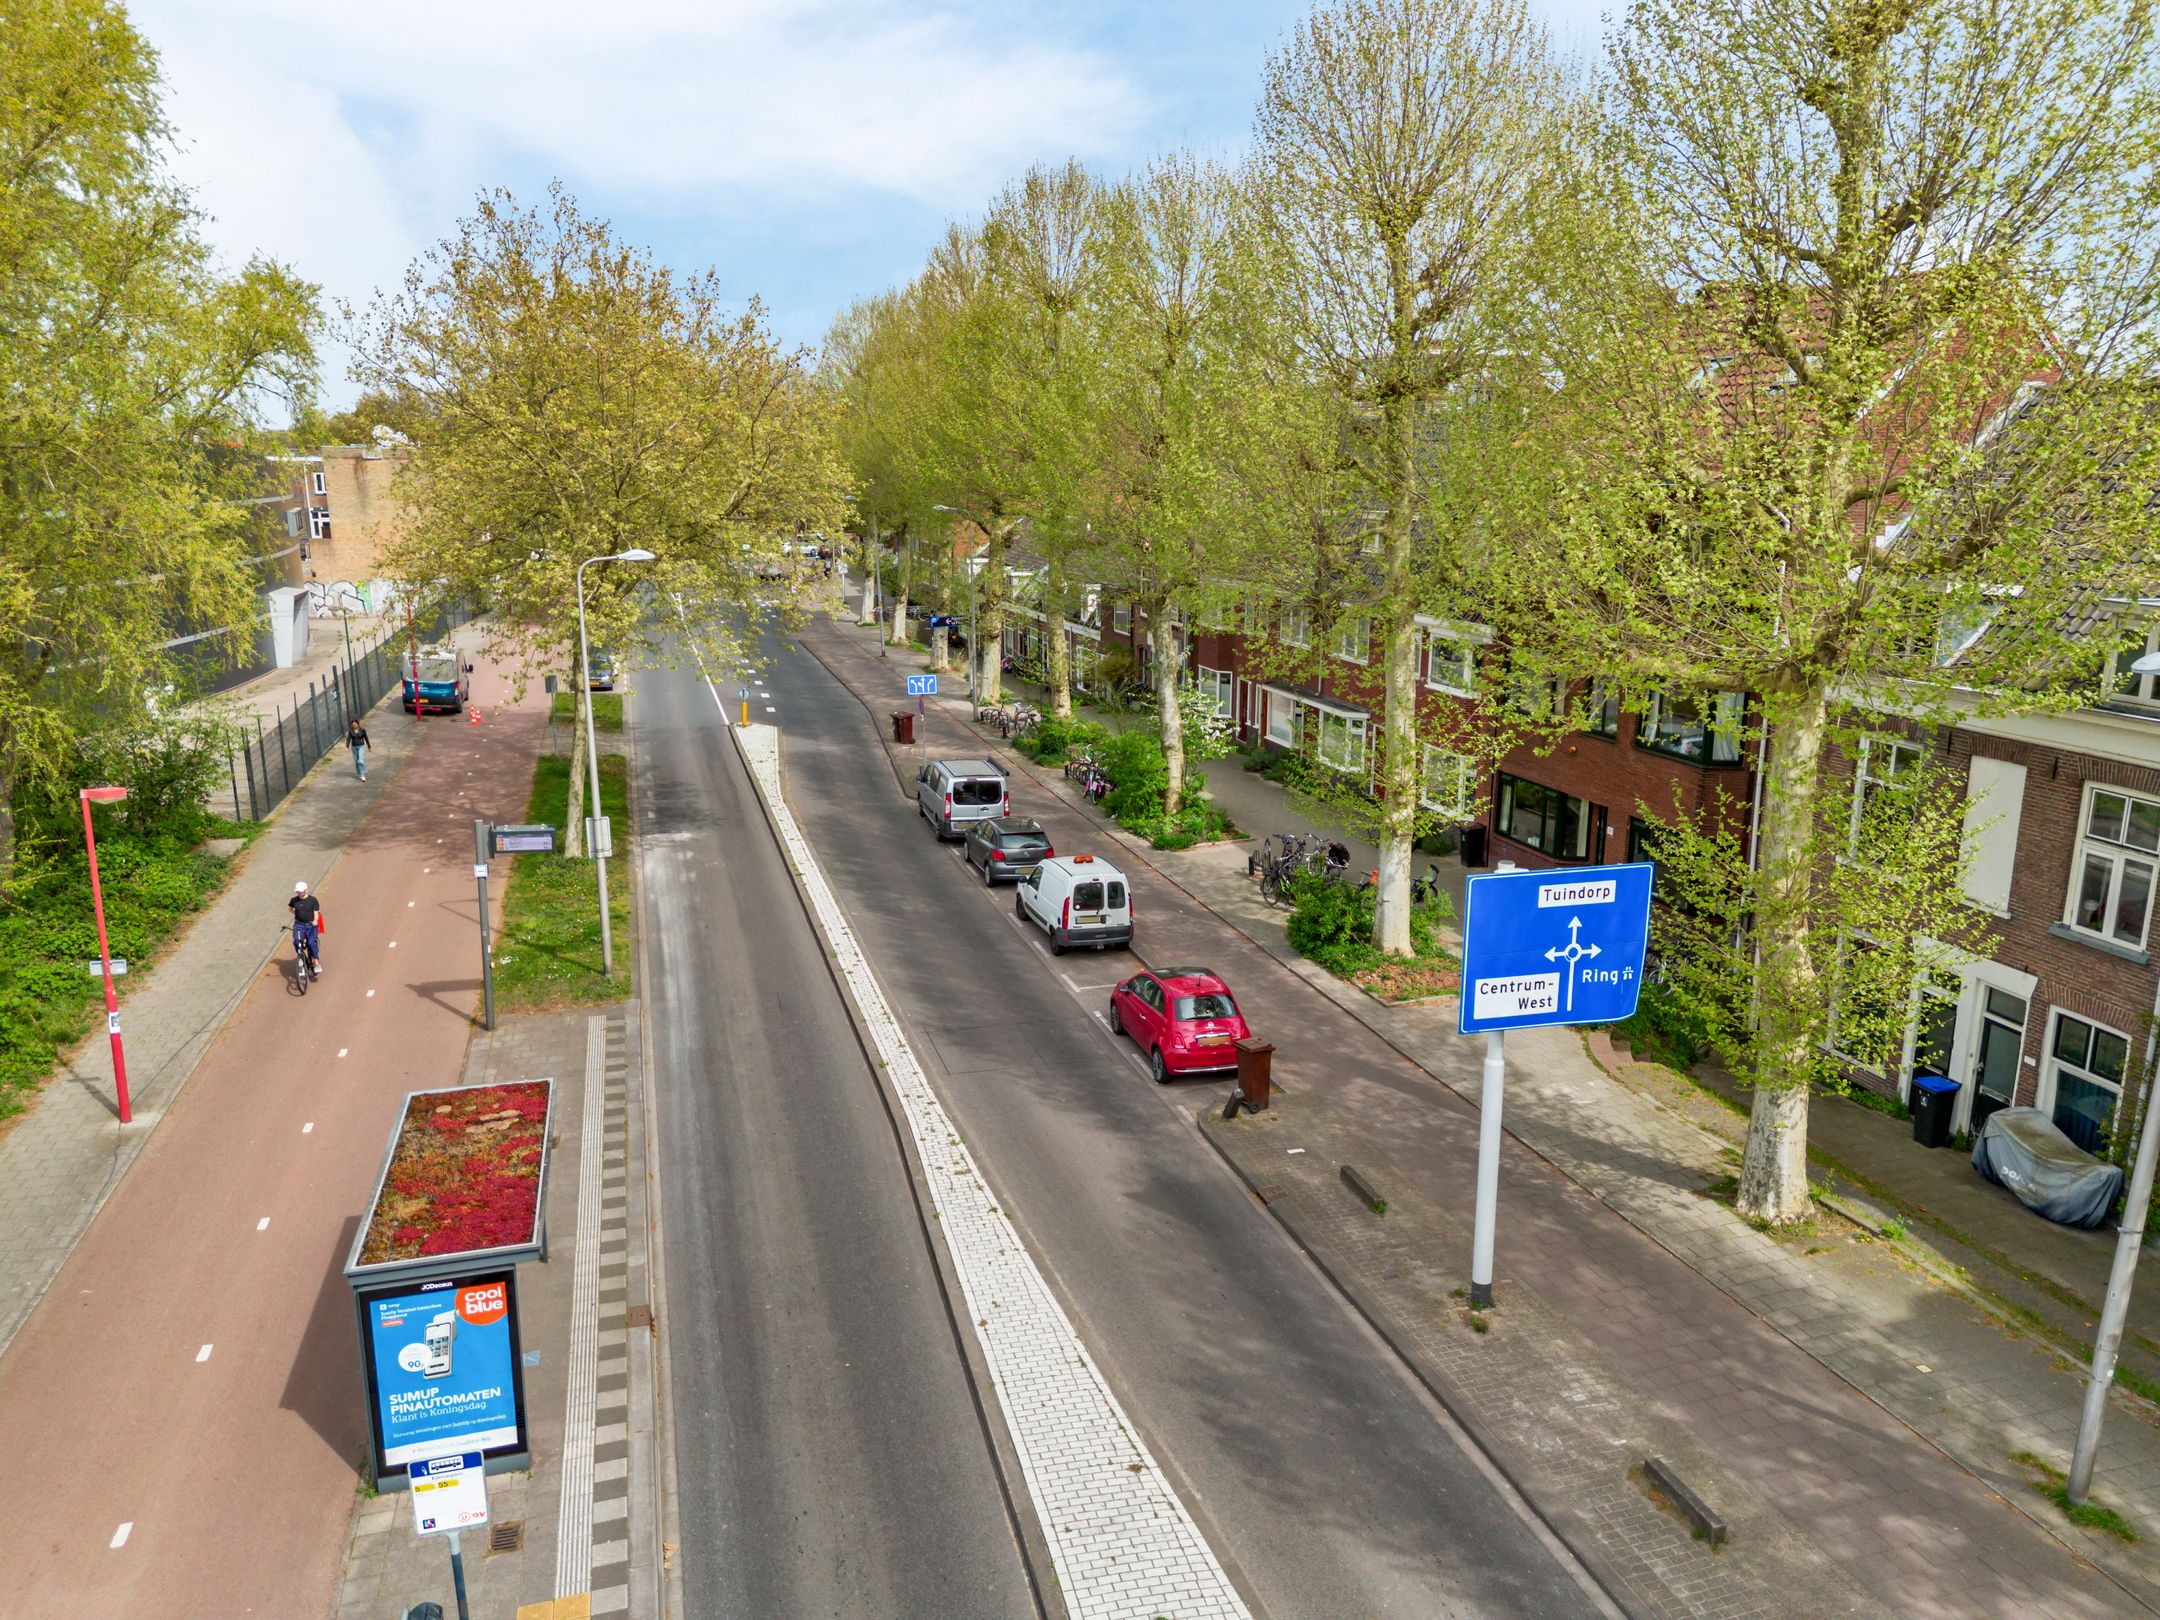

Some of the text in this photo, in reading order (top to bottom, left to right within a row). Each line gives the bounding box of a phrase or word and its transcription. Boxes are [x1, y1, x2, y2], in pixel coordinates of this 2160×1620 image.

[1544, 886, 1610, 902] Tuindorp
[1582, 969, 1618, 985] Ring
[1480, 980, 1554, 995] Centrum-
[1518, 996, 1552, 1010] West
[465, 1286, 503, 1302] cool
[466, 1299, 504, 1315] blue
[389, 1387, 439, 1405] SUMUP
[390, 1386, 501, 1415] PINAUTOMATEN
[391, 1414, 418, 1424] Klant
[420, 1411, 428, 1419] is
